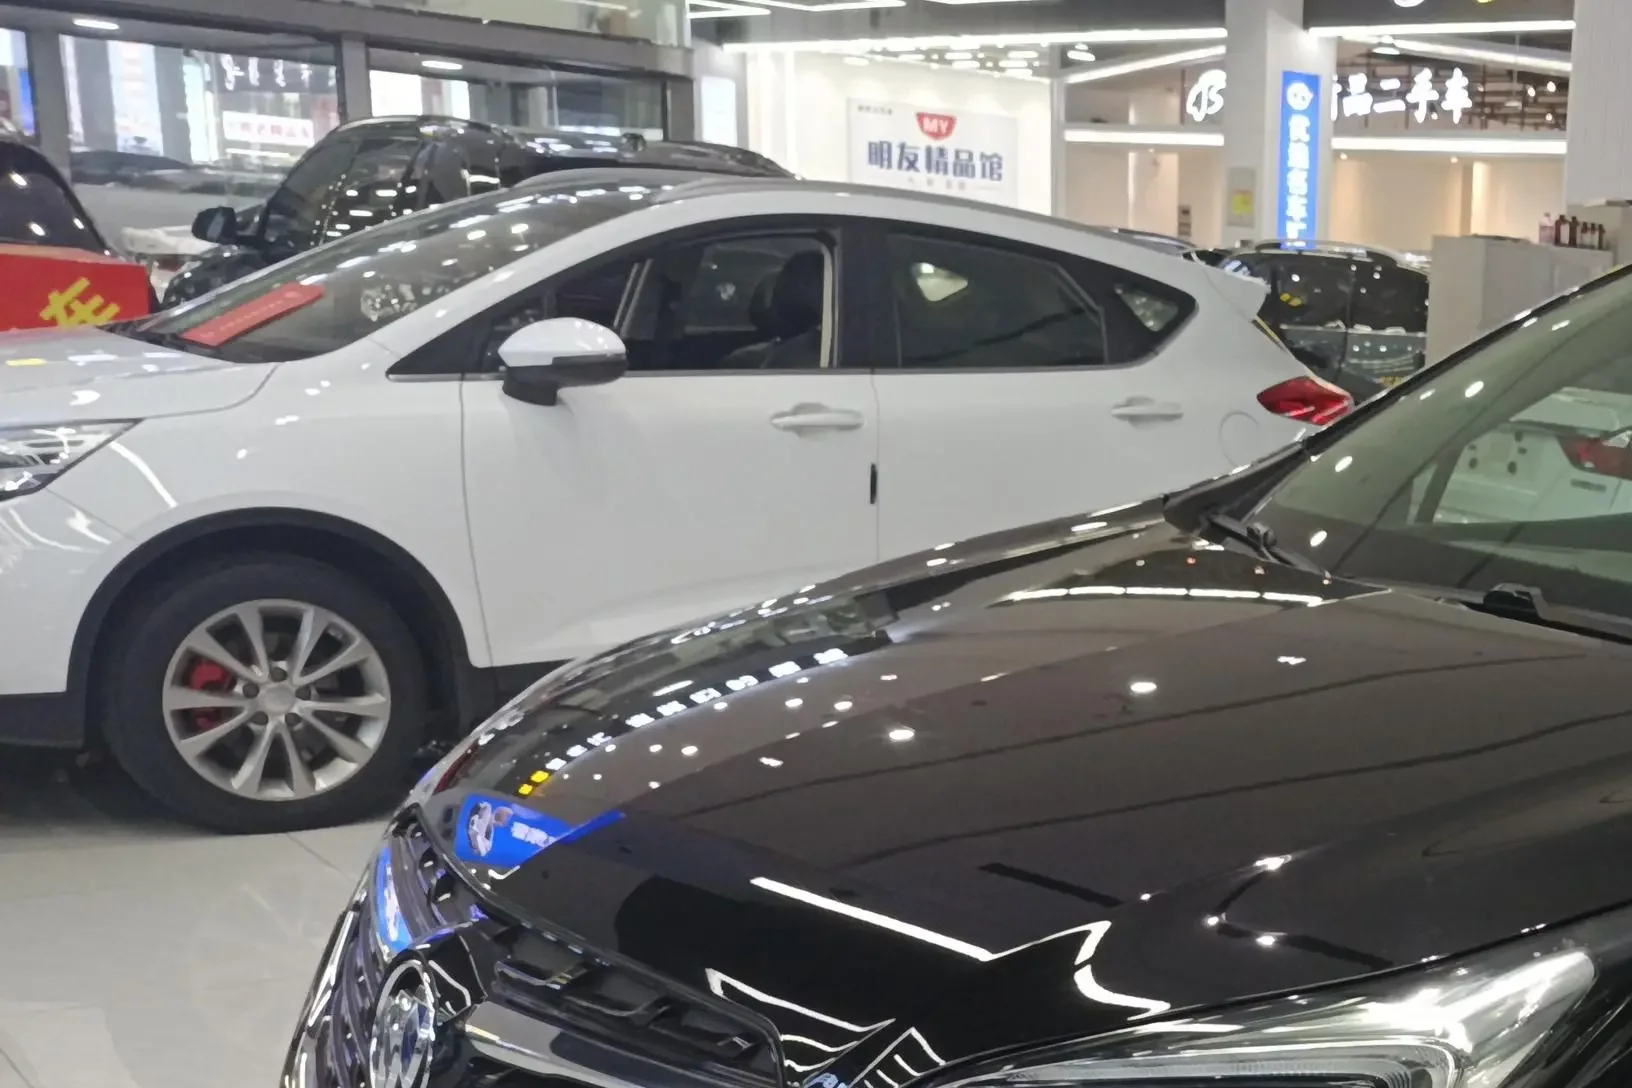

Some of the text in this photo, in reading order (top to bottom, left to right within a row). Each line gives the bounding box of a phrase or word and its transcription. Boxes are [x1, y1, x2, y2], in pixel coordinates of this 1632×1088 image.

[922, 116, 949, 135] MY
[867, 140, 1004, 182] 明友精品馆
